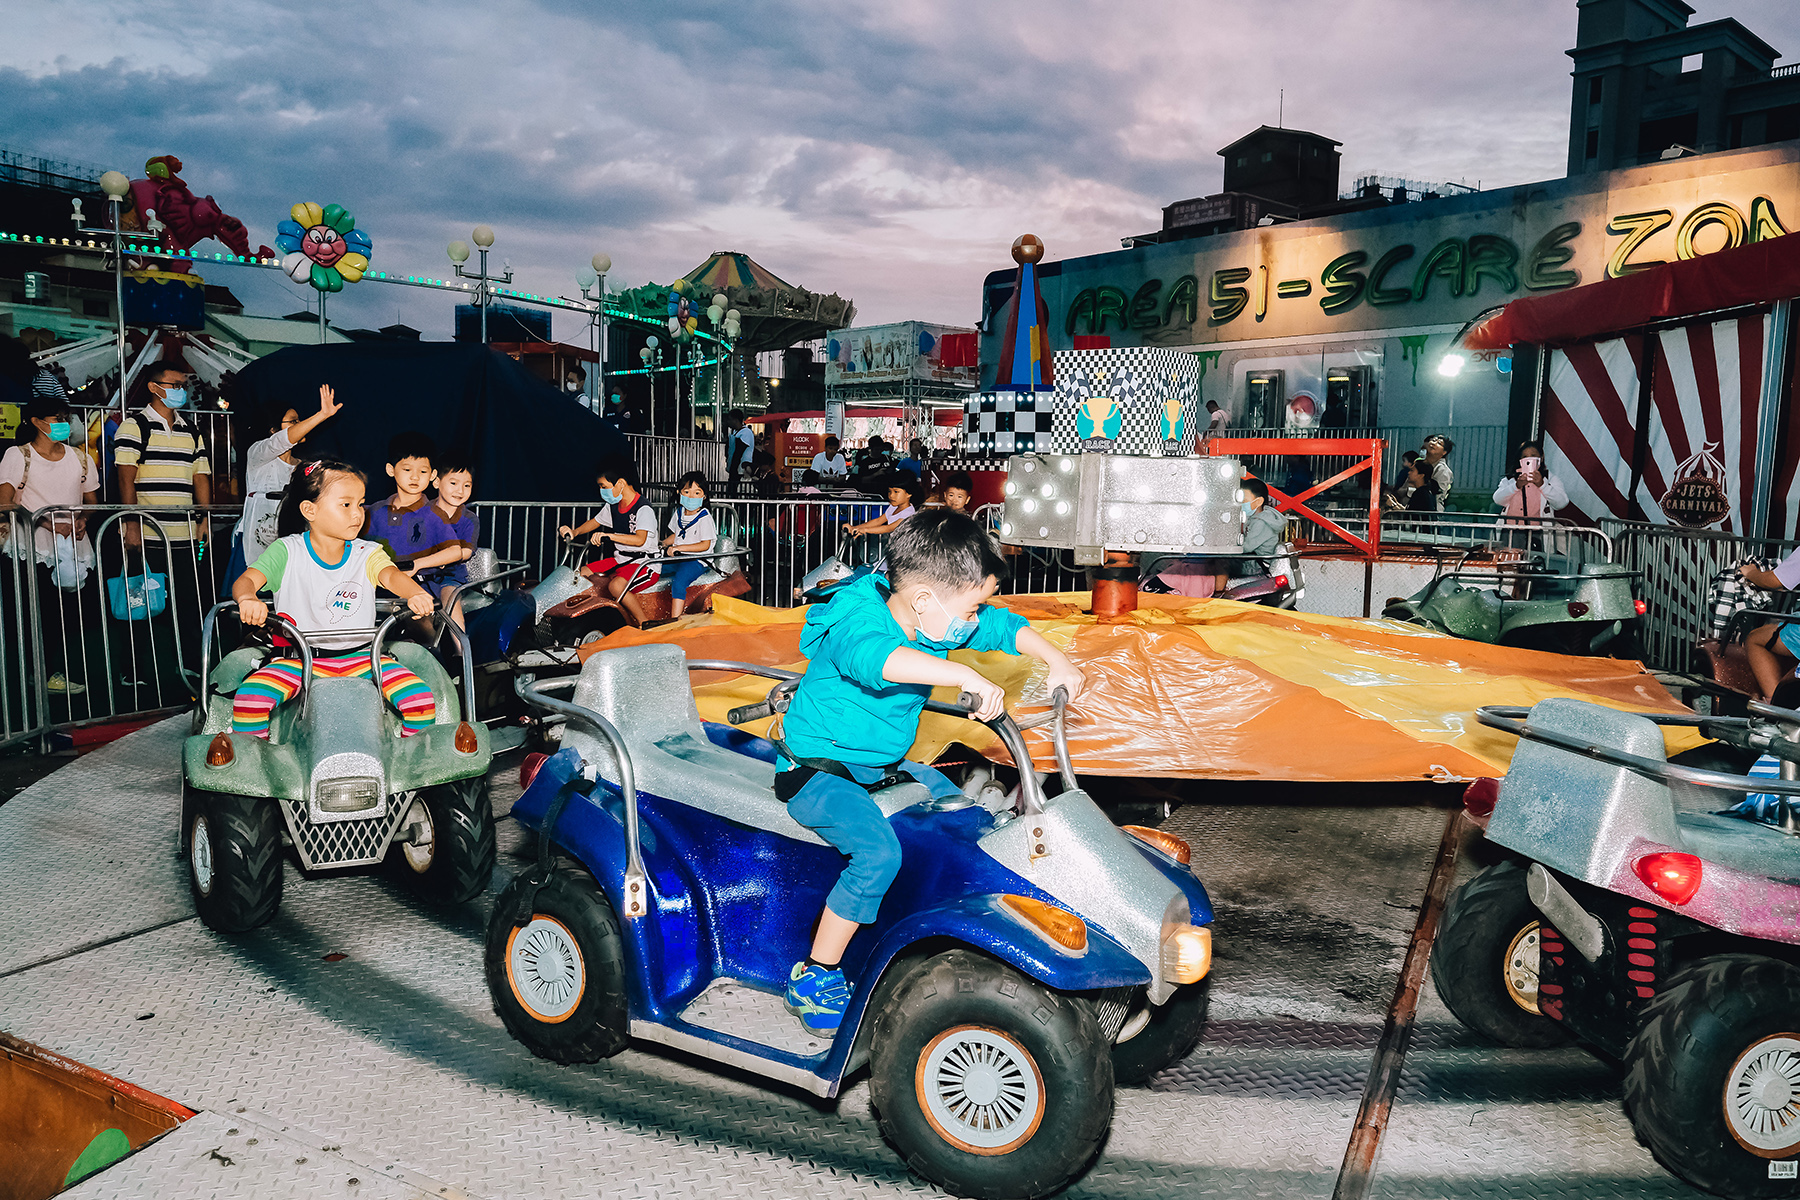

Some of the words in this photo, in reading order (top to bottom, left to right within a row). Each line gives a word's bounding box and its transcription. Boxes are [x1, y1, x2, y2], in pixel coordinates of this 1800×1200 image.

[1066, 274, 1198, 335] AREA
[1472, 351, 1501, 362] EXIT
[1085, 440, 1111, 449] RACE
[1680, 484, 1711, 498] JETS
[1665, 499, 1724, 512] CARNIVAL
[336, 591, 358, 599] HUG
[333, 601, 352, 611] ME
